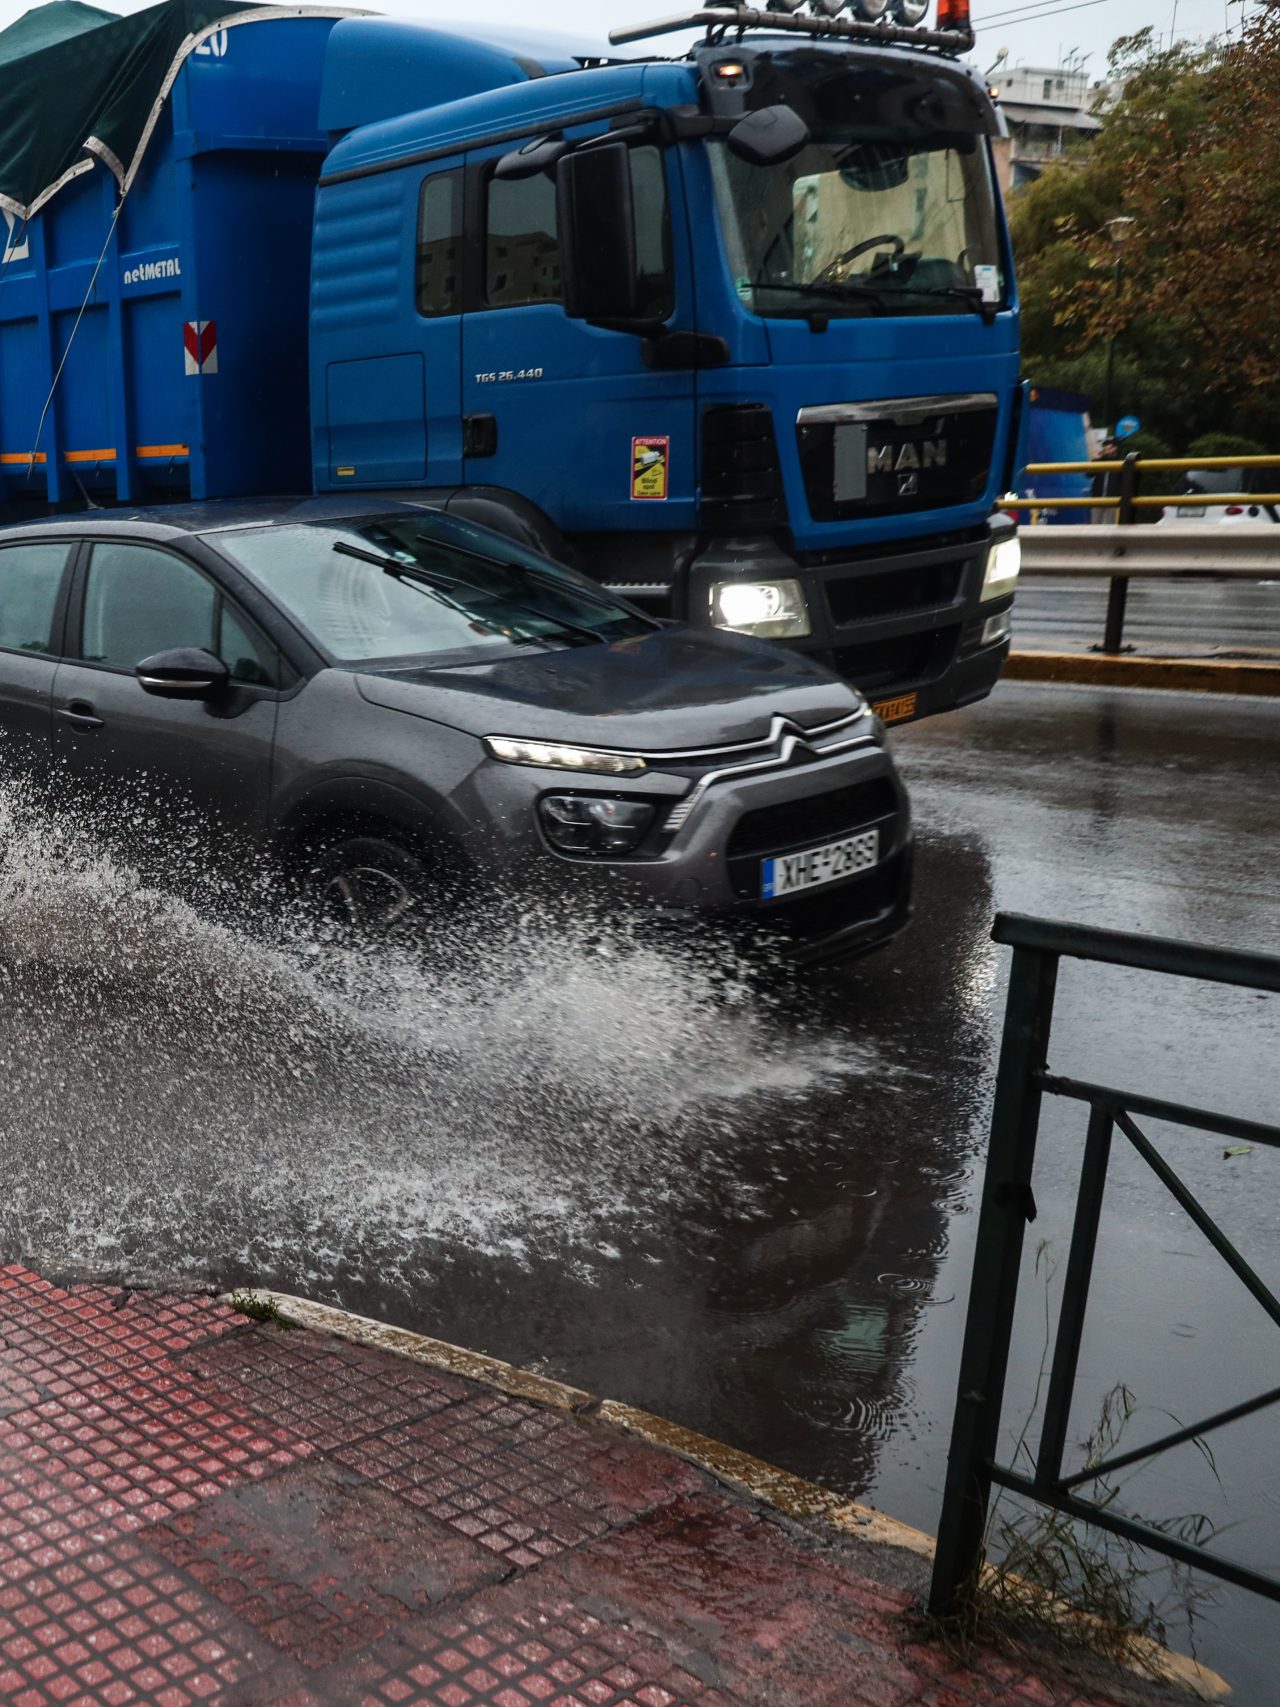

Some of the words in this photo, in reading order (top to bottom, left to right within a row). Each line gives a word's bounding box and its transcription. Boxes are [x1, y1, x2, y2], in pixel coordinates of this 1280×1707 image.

[474, 372, 497, 384] TGS
[498, 367, 543, 381] 26.440
[867, 439, 948, 475] MAN
